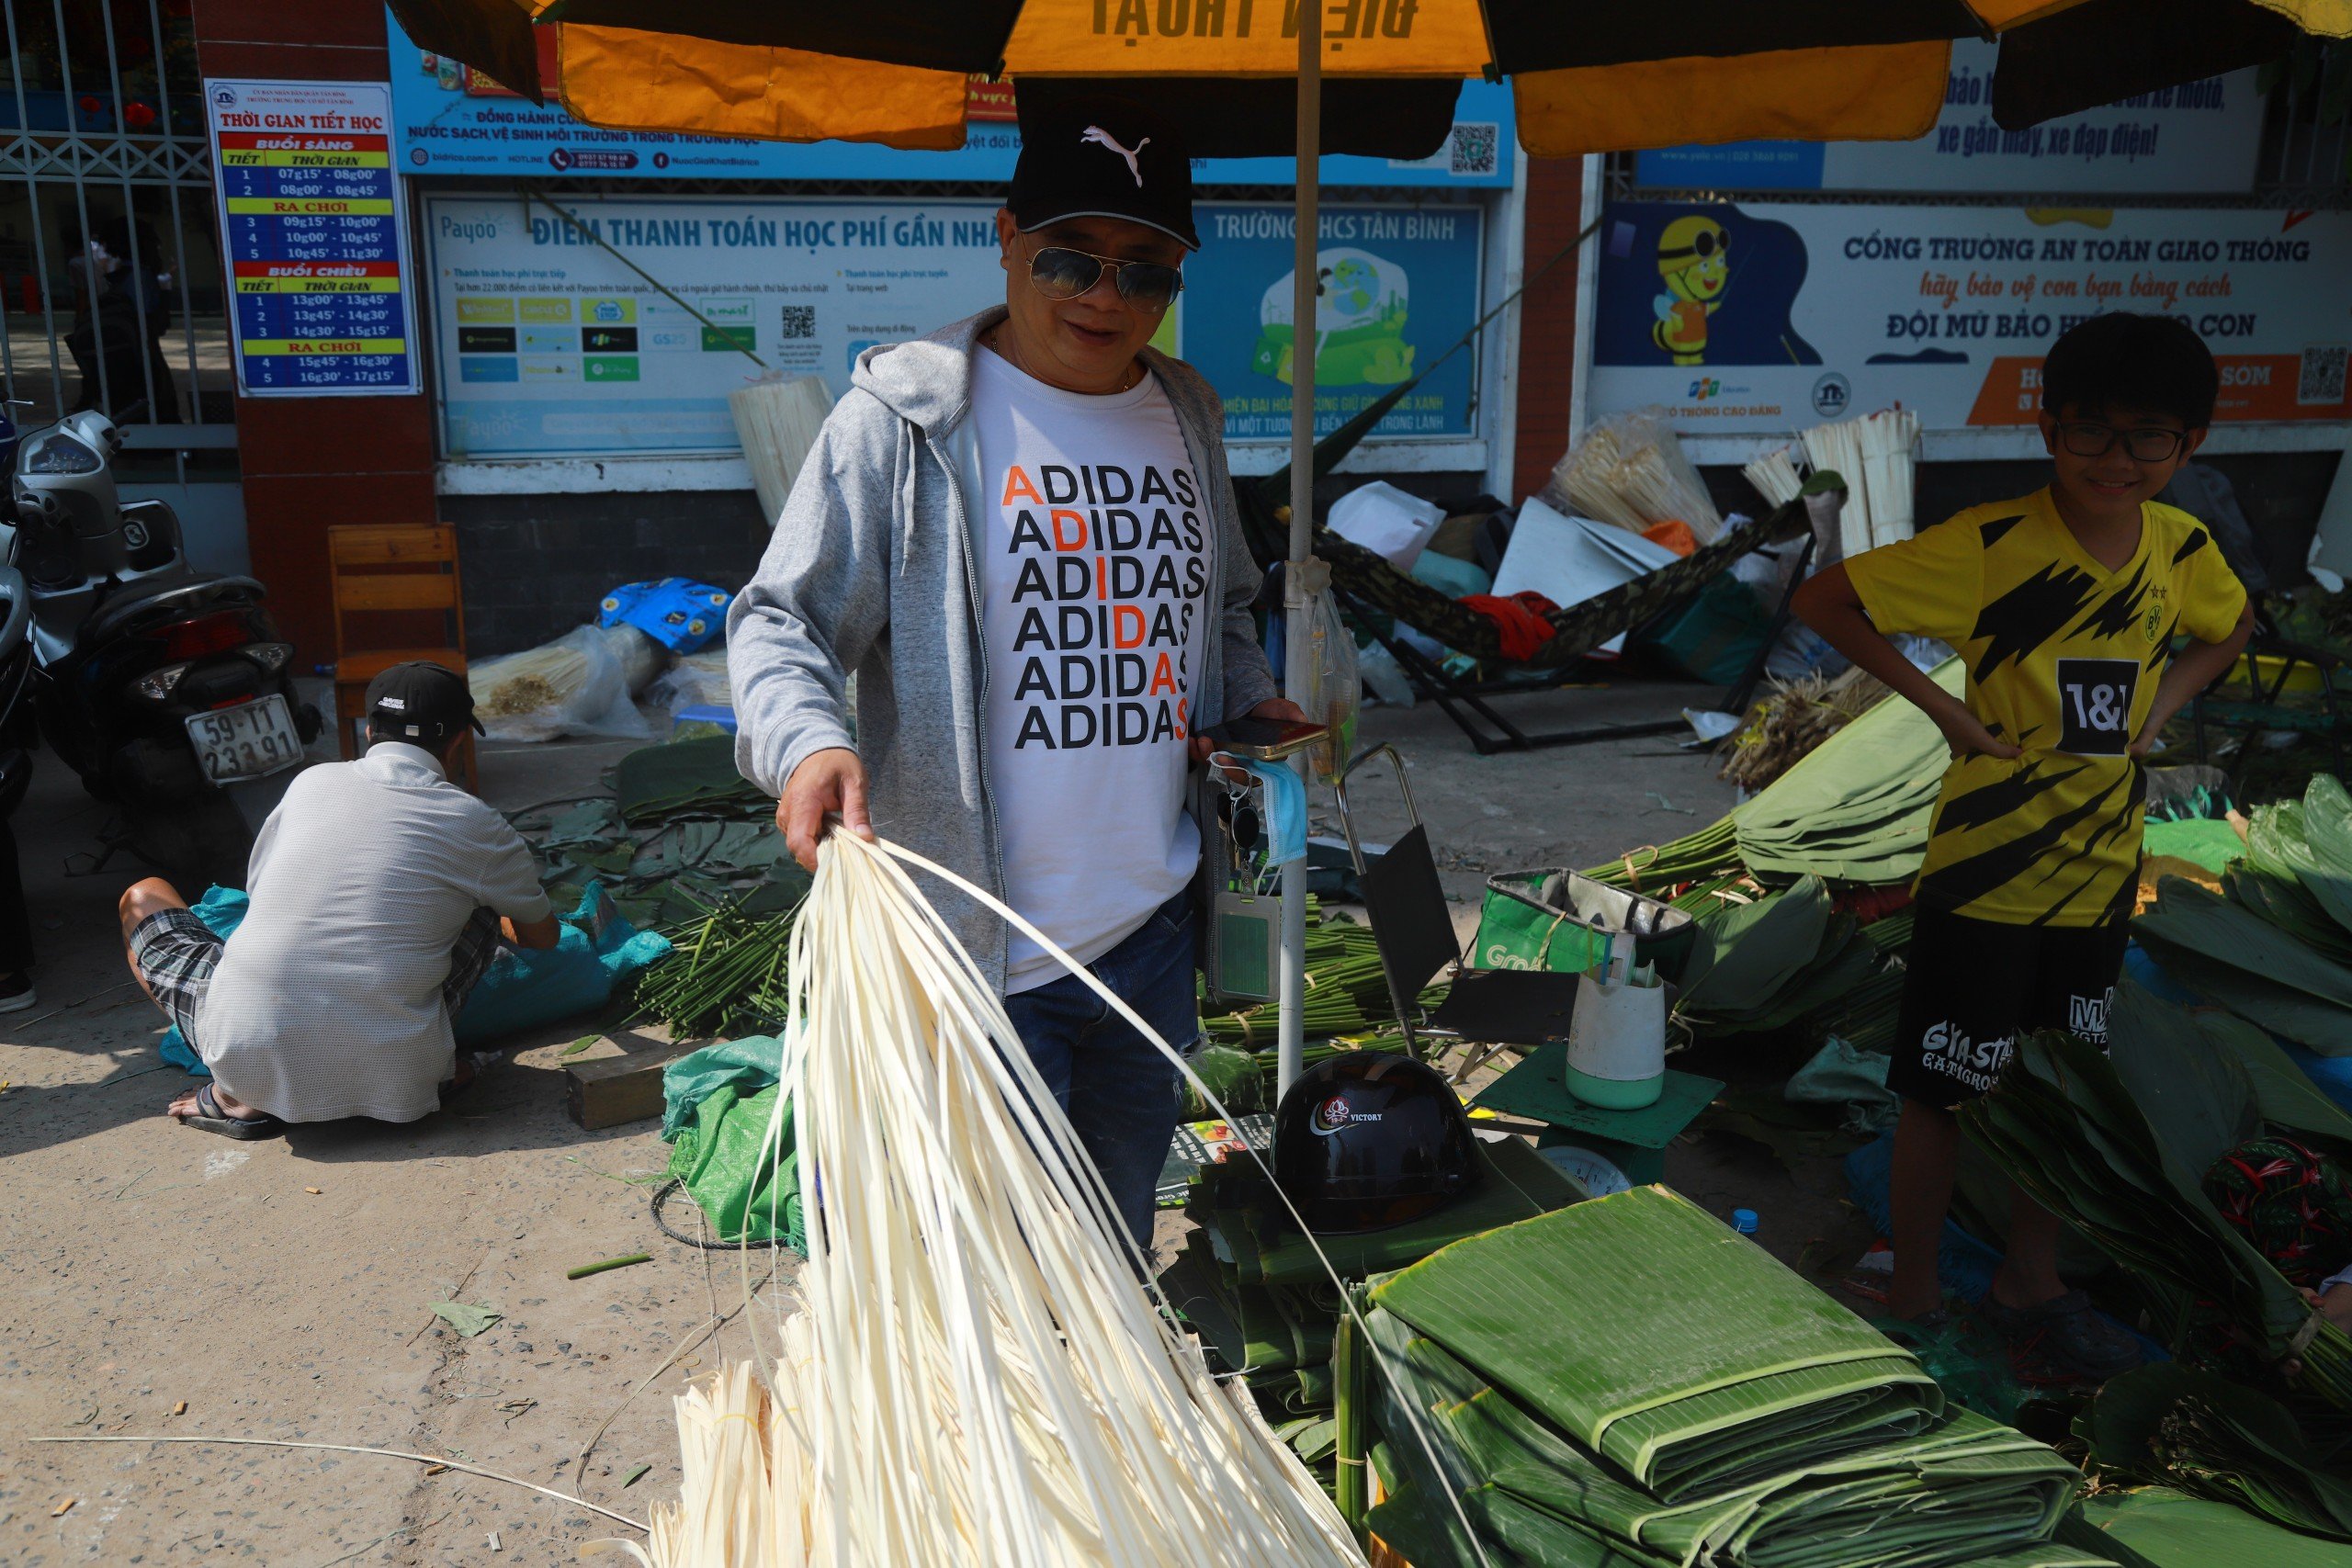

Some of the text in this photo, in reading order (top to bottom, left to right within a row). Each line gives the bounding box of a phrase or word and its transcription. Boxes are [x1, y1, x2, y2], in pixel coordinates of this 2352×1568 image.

[220, 110, 383, 132] THỜI GIAN TIẾT HỌC
[512, 130, 544, 141] SINH
[1938, 125, 1960, 153] xe
[1962, 115, 1998, 157] gắn
[2048, 130, 2071, 154] xe
[2073, 122, 2109, 162] đạp
[2110, 122, 2158, 163] điện!
[255, 136, 355, 151] BUỔI SÁNG
[228, 152, 360, 165] TIẾT THỜI GIAN
[243, 169, 376, 181] 1 07g15' 08g00'
[244, 185, 378, 197] 2 08g00' 08g45'
[274, 201, 349, 212] RA CHƠI
[247, 217, 380, 229] 3 09g15' 10g00'
[1318, 215, 1356, 240] HCS
[1361, 212, 1400, 240] TÂN
[1405, 212, 1455, 241] BÌNH
[248, 232, 382, 244] 4 10g00' 10g45'
[440, 216, 497, 243] Payoo
[608, 219, 701, 246] THANH
[707, 215, 776, 246] TOÁN
[785, 220, 835, 254] HỌC
[842, 216, 888, 246] PHÍ
[894, 214, 944, 246] GẦN
[251, 248, 383, 260] 5 10g45' 11g30'
[2040, 239, 2077, 261] AN
[2157, 240, 2221, 263] GIAO
[2227, 235, 2311, 262] THÔNG
[268, 263, 312, 276] BUỔI
[243, 280, 371, 292] TIẾT THỜI GIAN
[1919, 270, 1959, 310] hãy
[2011, 274, 2036, 302] vệ
[2042, 279, 2077, 297] con
[2086, 272, 2124, 303] bạn
[2185, 272, 2233, 297] cách
[256, 295, 388, 307] 1 13g00' 13g45'
[257, 310, 389, 321] 2 13g45' 14g30'
[259, 326, 390, 337] 3 14g30' 15g15'
[1886, 310, 1939, 343] ĐỘI
[2199, 314, 2257, 337] CON
[288, 341, 362, 353] RA CHƠI
[262, 356, 393, 367] 4 15g45' 16g30'
[264, 371, 394, 384] 5 16g30' 17g15'
[1723, 405, 1747, 416] CAO
[1001, 465, 1196, 509] ADIDAS
[1008, 508, 1204, 554] ADIDAS
[1011, 555, 1205, 603] ADIDAS
[1012, 603, 1193, 651] ADIDAS
[1013, 649, 1188, 701] ADIDAS
[1014, 696, 1188, 750] ADIDAS
[1350, 1113, 1383, 1122] VICTORY
[1593, 1174, 1598, 1182] 1
